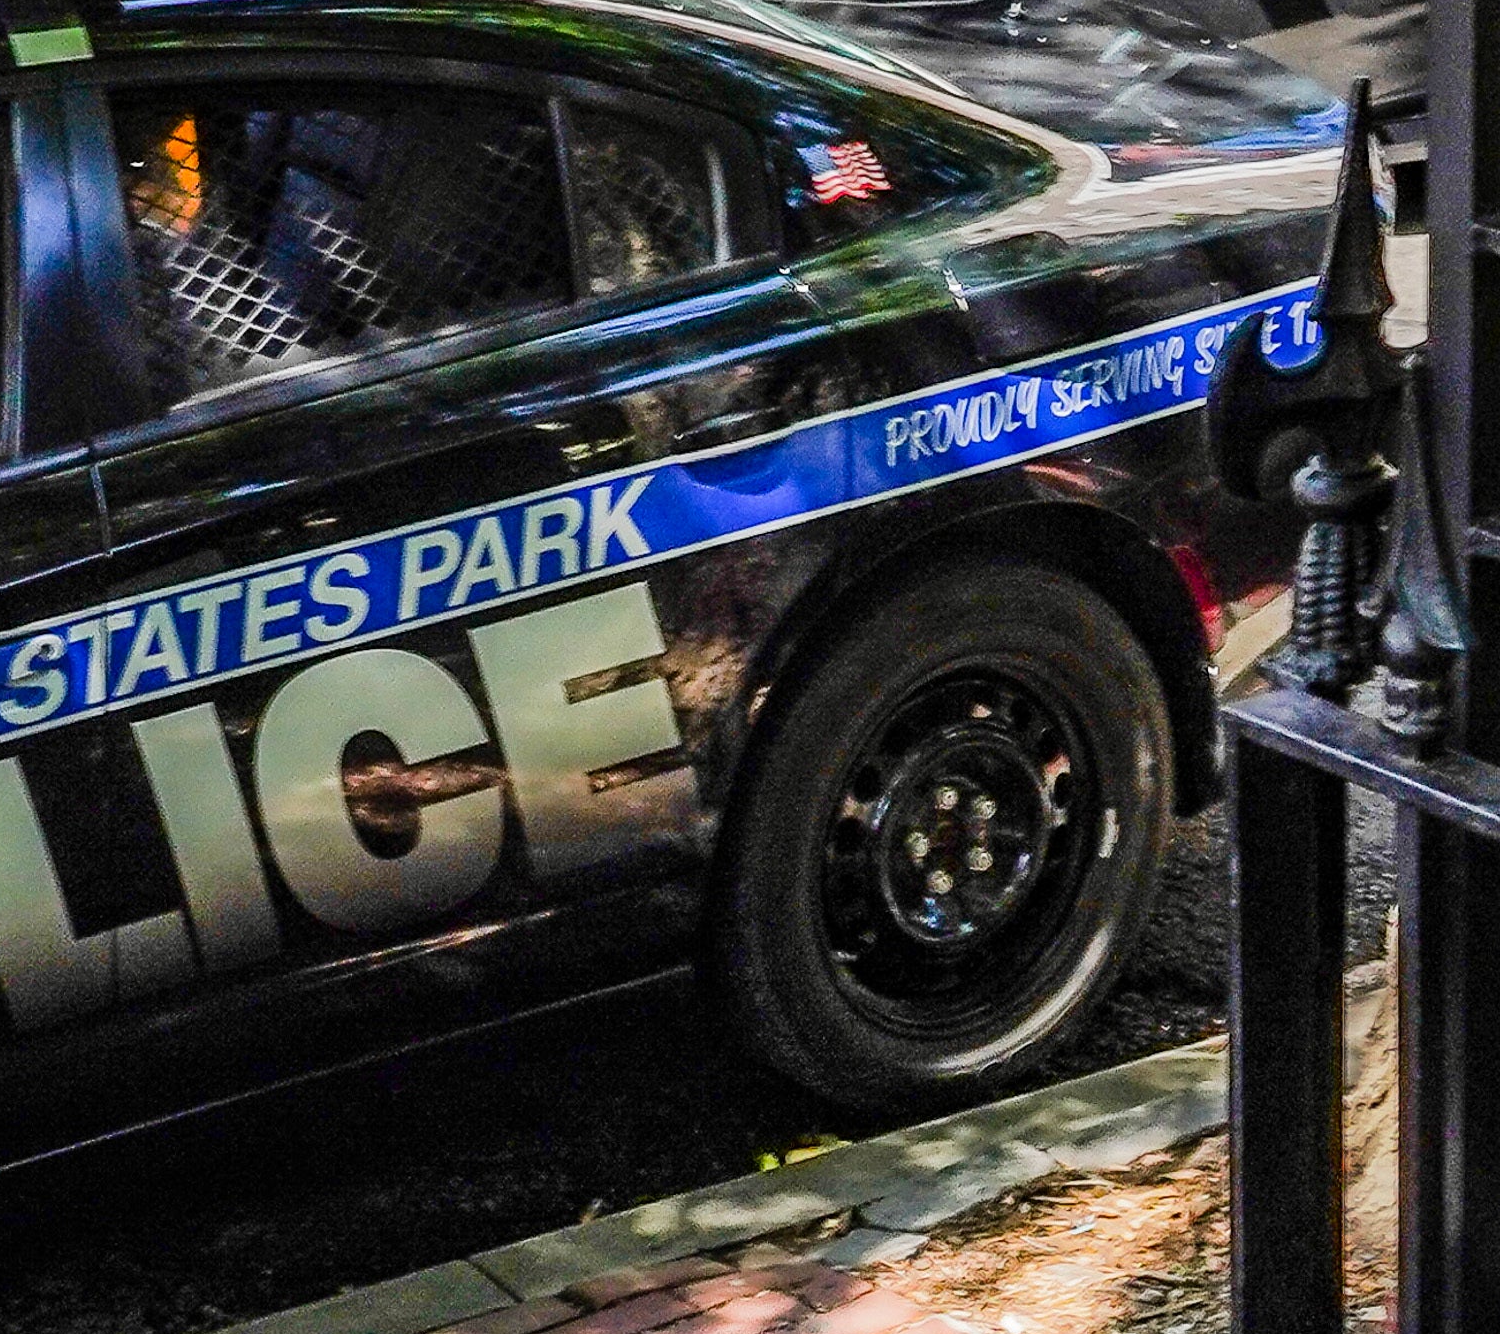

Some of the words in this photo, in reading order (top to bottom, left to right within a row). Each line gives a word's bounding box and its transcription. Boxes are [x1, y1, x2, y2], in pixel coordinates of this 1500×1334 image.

[885, 376, 1041, 468] PROUDLY
[1050, 335, 1185, 419] SERVING
[0, 551, 372, 726] STATES
[396, 475, 656, 622] PARK
